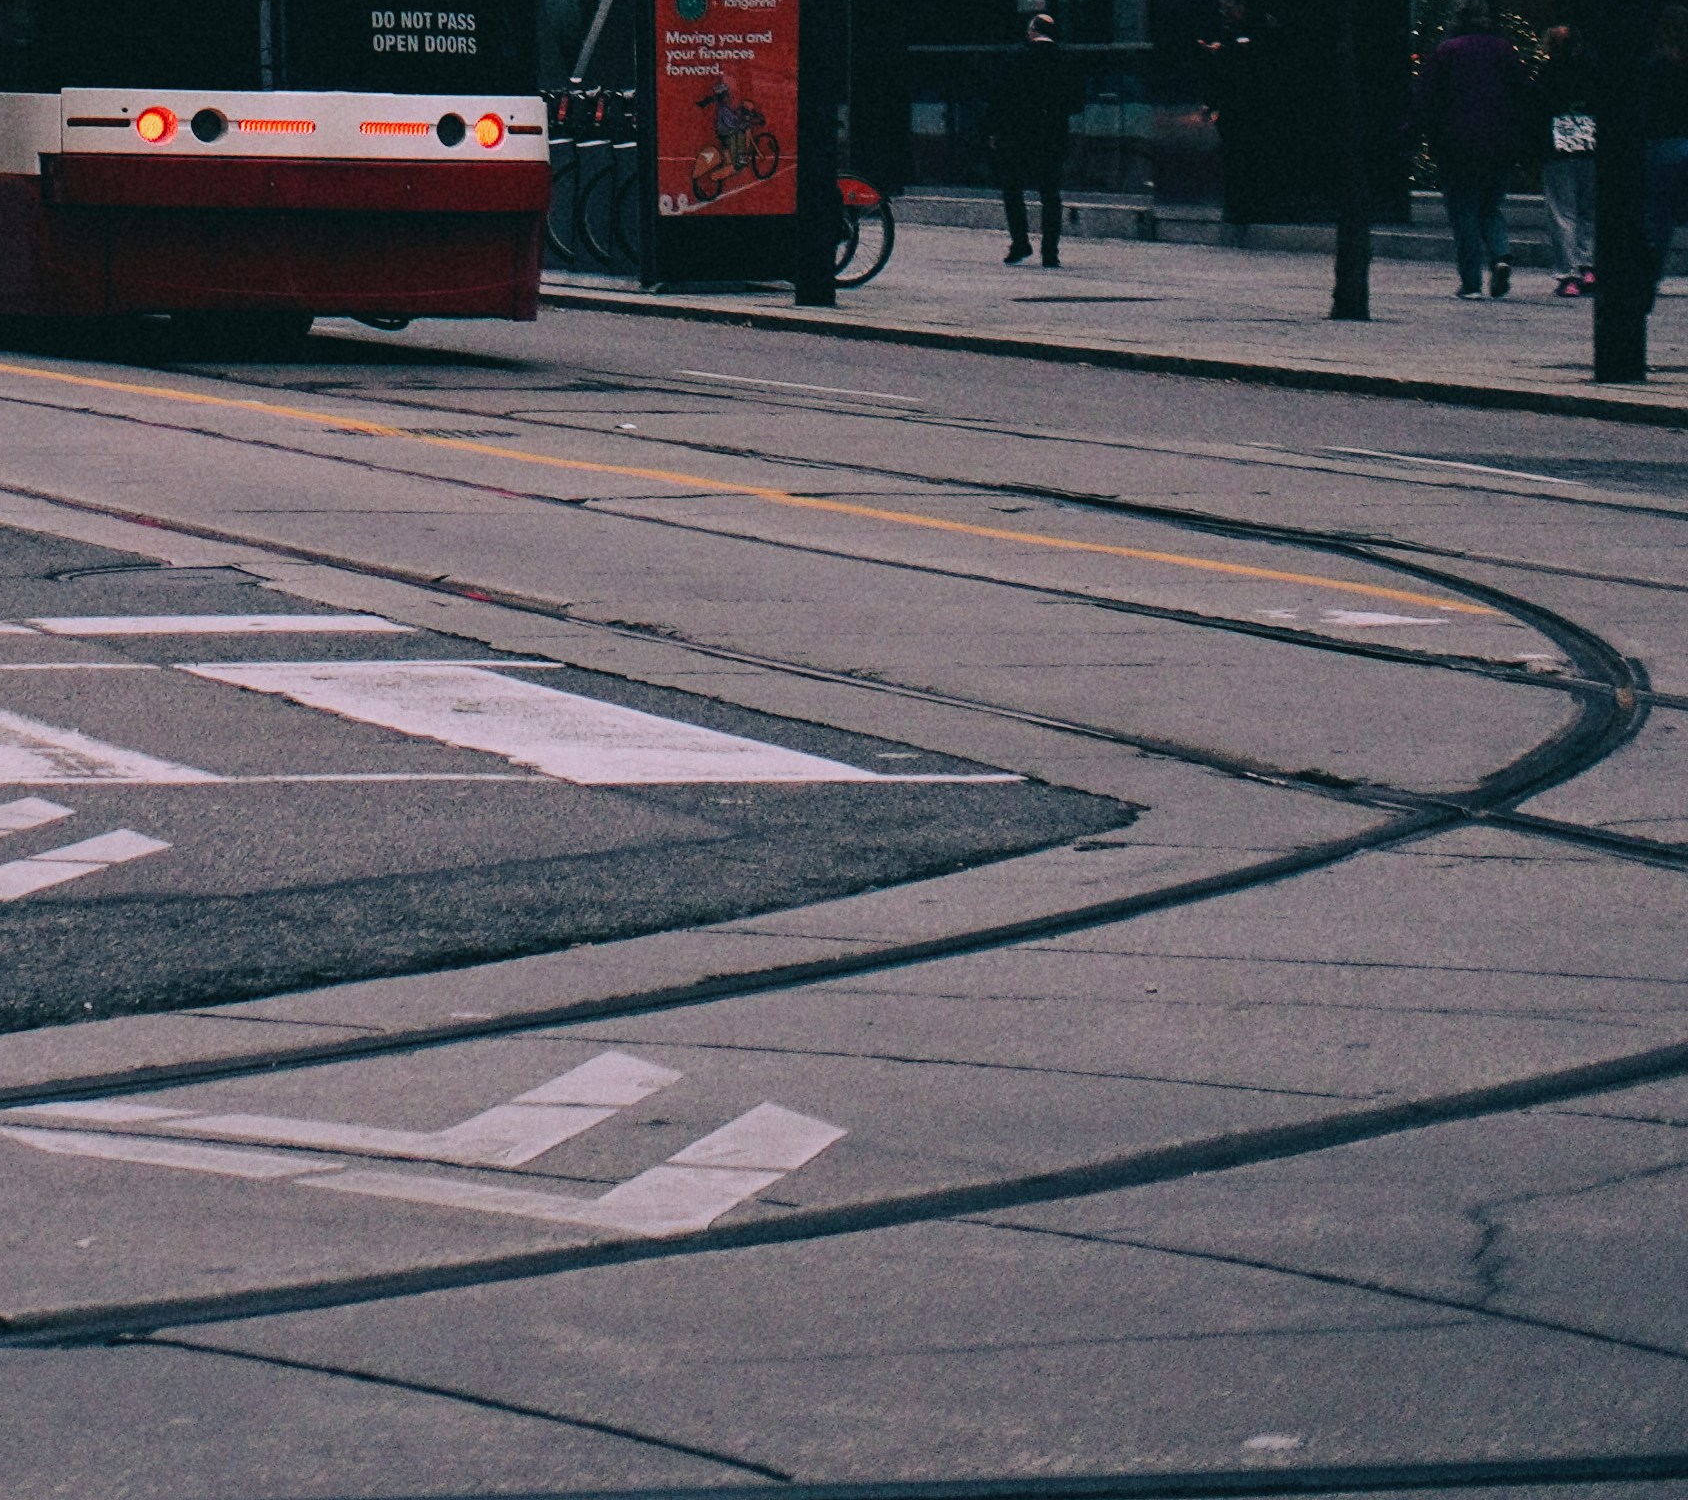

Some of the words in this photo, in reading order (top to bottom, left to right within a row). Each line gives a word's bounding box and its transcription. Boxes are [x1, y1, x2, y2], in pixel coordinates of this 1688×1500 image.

[371, 10, 395, 28] DO
[400, 11, 433, 29] NOT
[437, 12, 476, 31] PASS
[372, 34, 419, 52] OPEN
[424, 35, 477, 54] DOORS
[665, 31, 715, 46] Moving
[718, 33, 743, 47] you
[745, 30, 773, 44] and
[664, 50, 695, 62] your
[698, 46, 755, 60] finances
[665, 63, 724, 76] forward.
